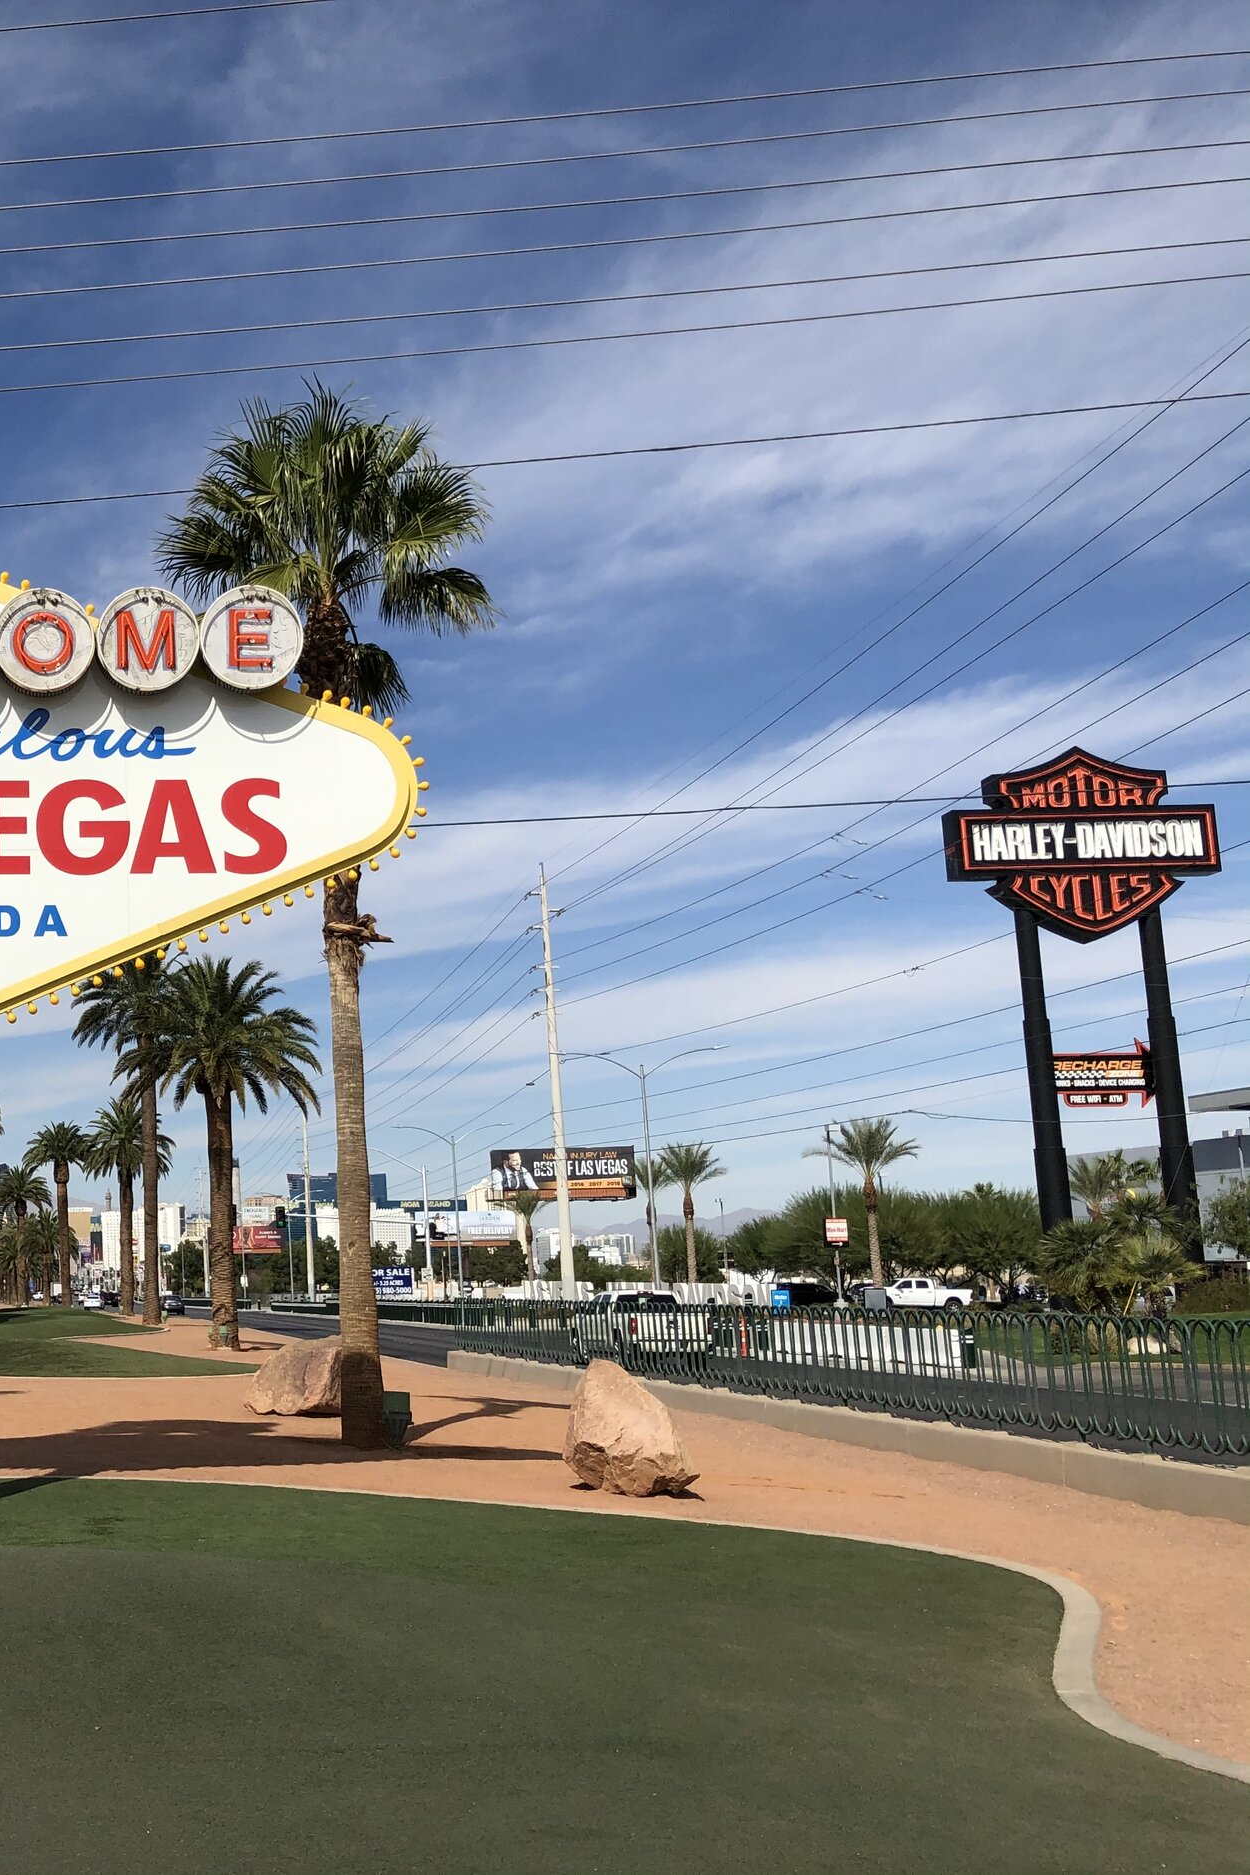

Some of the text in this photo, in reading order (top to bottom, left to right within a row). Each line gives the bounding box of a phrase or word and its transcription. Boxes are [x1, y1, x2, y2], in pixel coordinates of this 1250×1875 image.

[1021, 767, 1144, 808] MOTOR
[972, 819, 1204, 861] HARLEY-DAVIDSON
[1029, 872, 1151, 920] CYCLES
[1053, 1060, 1143, 1071] RECHARGE
[1109, 1070, 1141, 1078] ZONE
[1118, 1078, 1146, 1086] CHARGING
[1070, 1095, 1086, 1103] FREE
[1109, 1095, 1123, 1103] ATM
[570, 1152, 597, 1160] INJURY
[600, 1151, 617, 1159] LAW
[533, 1161, 557, 1177] BEST
[576, 1160, 594, 1176] LAS
[595, 1158, 628, 1175] VEGAS
[467, 1226, 513, 1235] FREE DELIVERY
[386, 1268, 410, 1276] SALE
[382, 1286, 412, 1294] 980-5000
